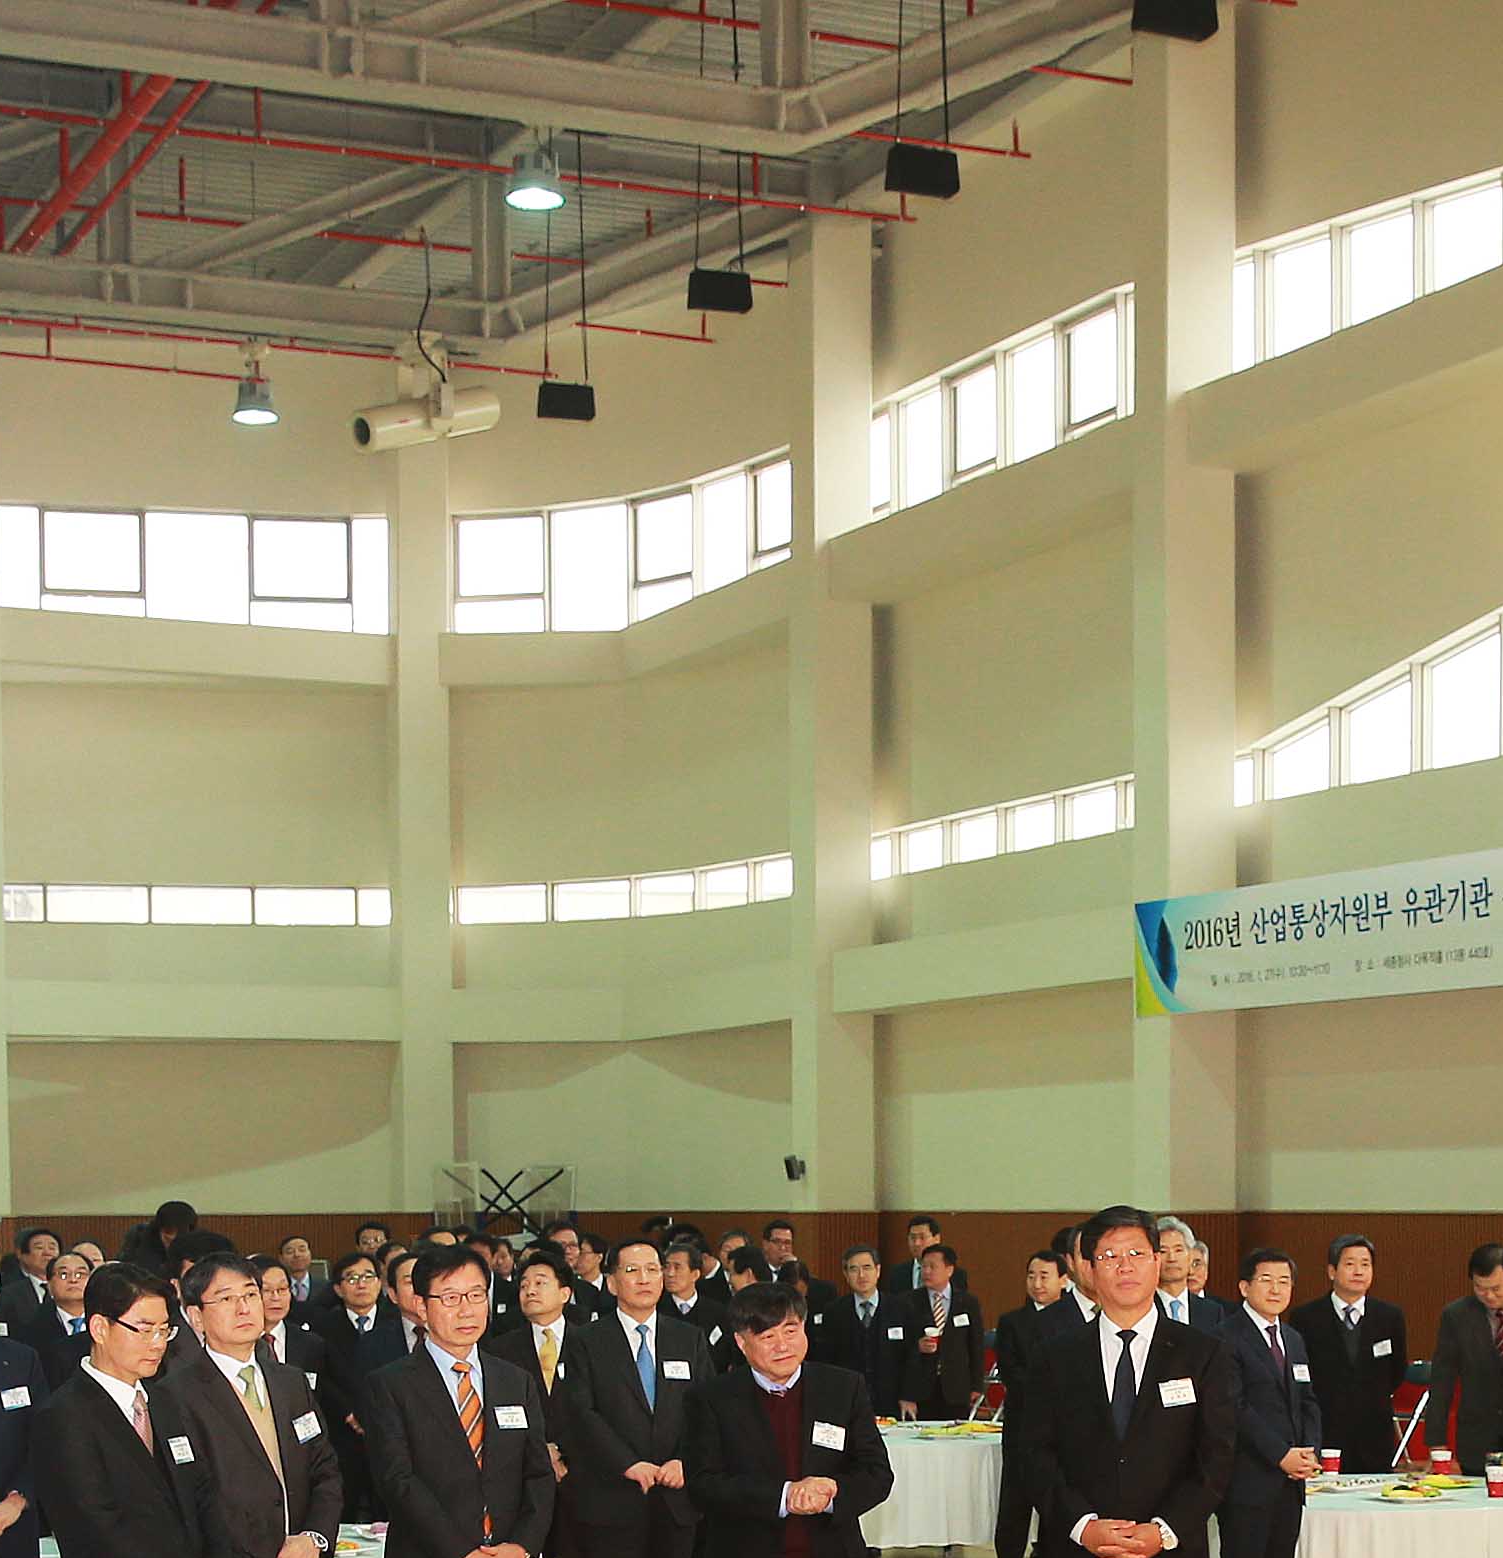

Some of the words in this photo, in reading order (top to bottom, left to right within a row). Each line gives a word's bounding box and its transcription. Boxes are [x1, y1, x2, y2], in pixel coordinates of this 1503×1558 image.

[1184, 910, 1241, 951] 2016년
[1249, 891, 1392, 945] 산업통상자원부
[1401, 877, 1493, 927] 유관기관
